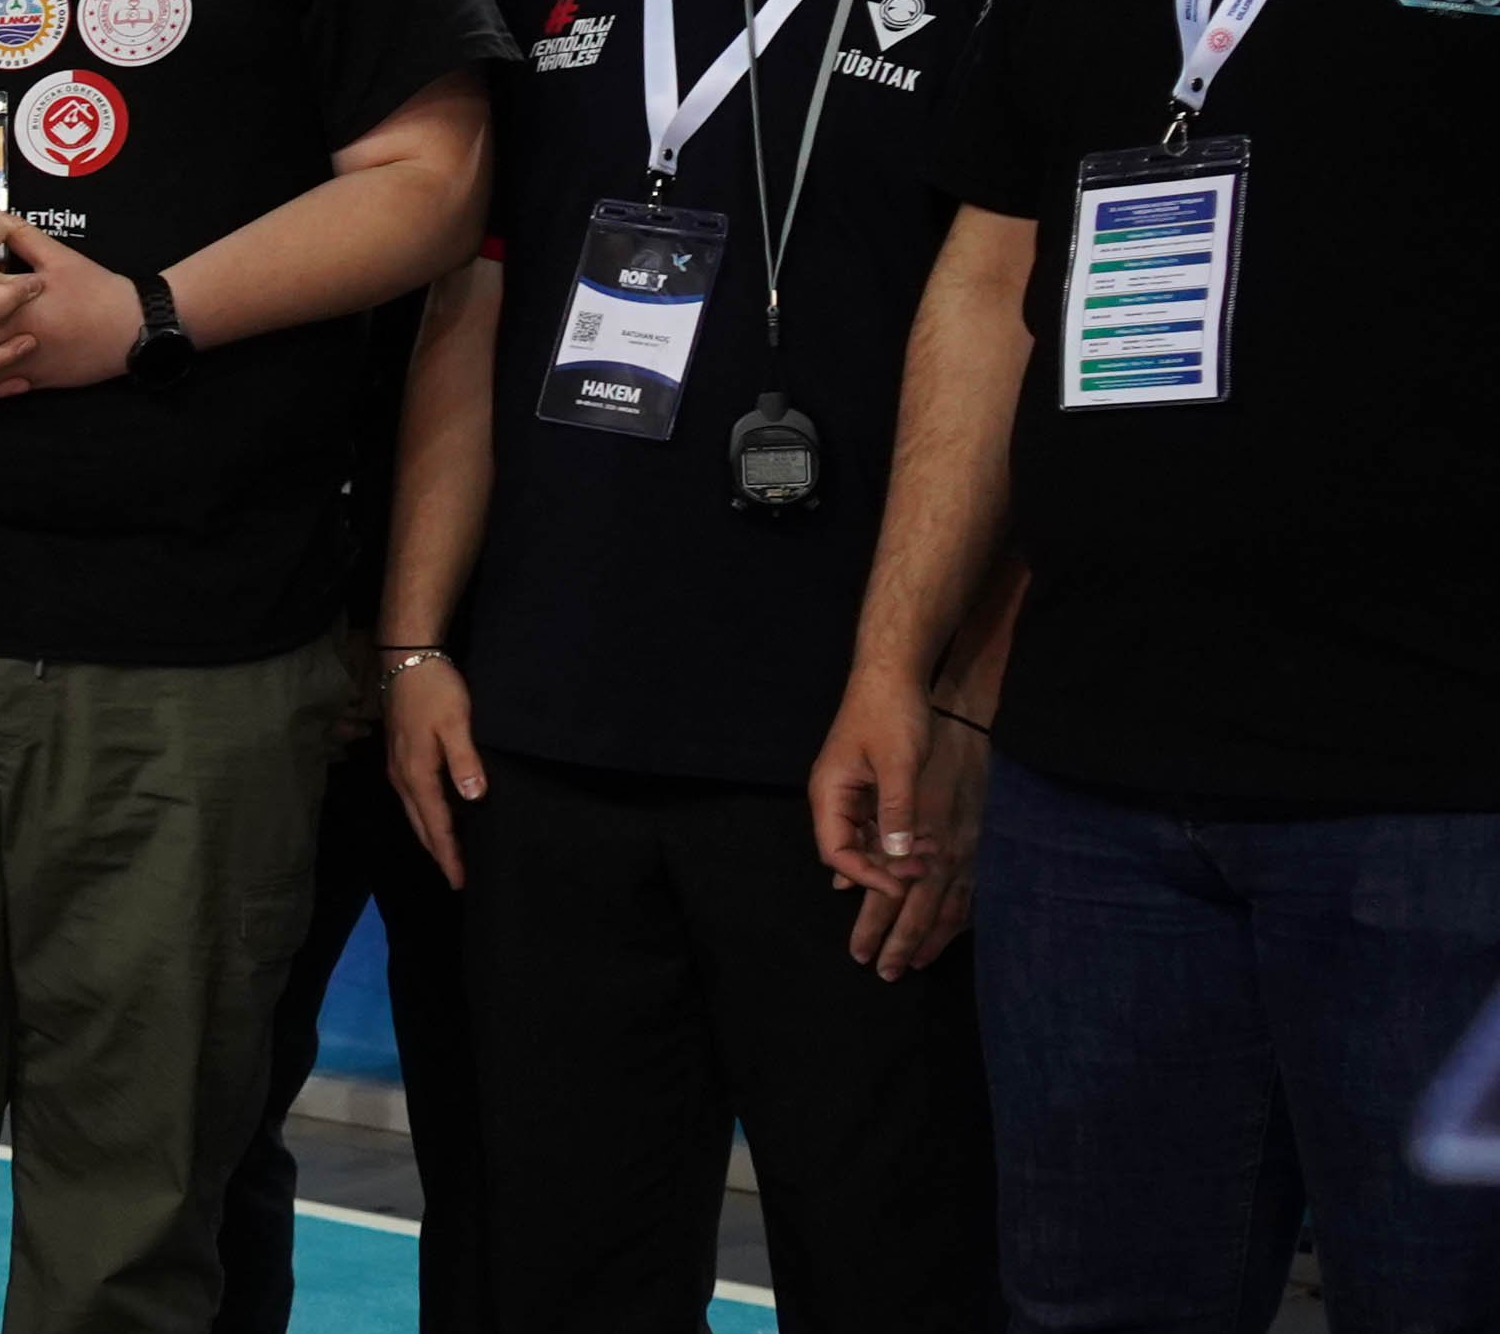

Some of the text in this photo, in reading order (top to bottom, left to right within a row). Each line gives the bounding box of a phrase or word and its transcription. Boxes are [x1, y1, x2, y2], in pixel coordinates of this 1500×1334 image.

[51, 9, 67, 41] ODASI
[832, 48, 922, 92] TÜBİTAK
[32, 88, 62, 131] BULANCAK
[580, 379, 642, 404] HAKEM
